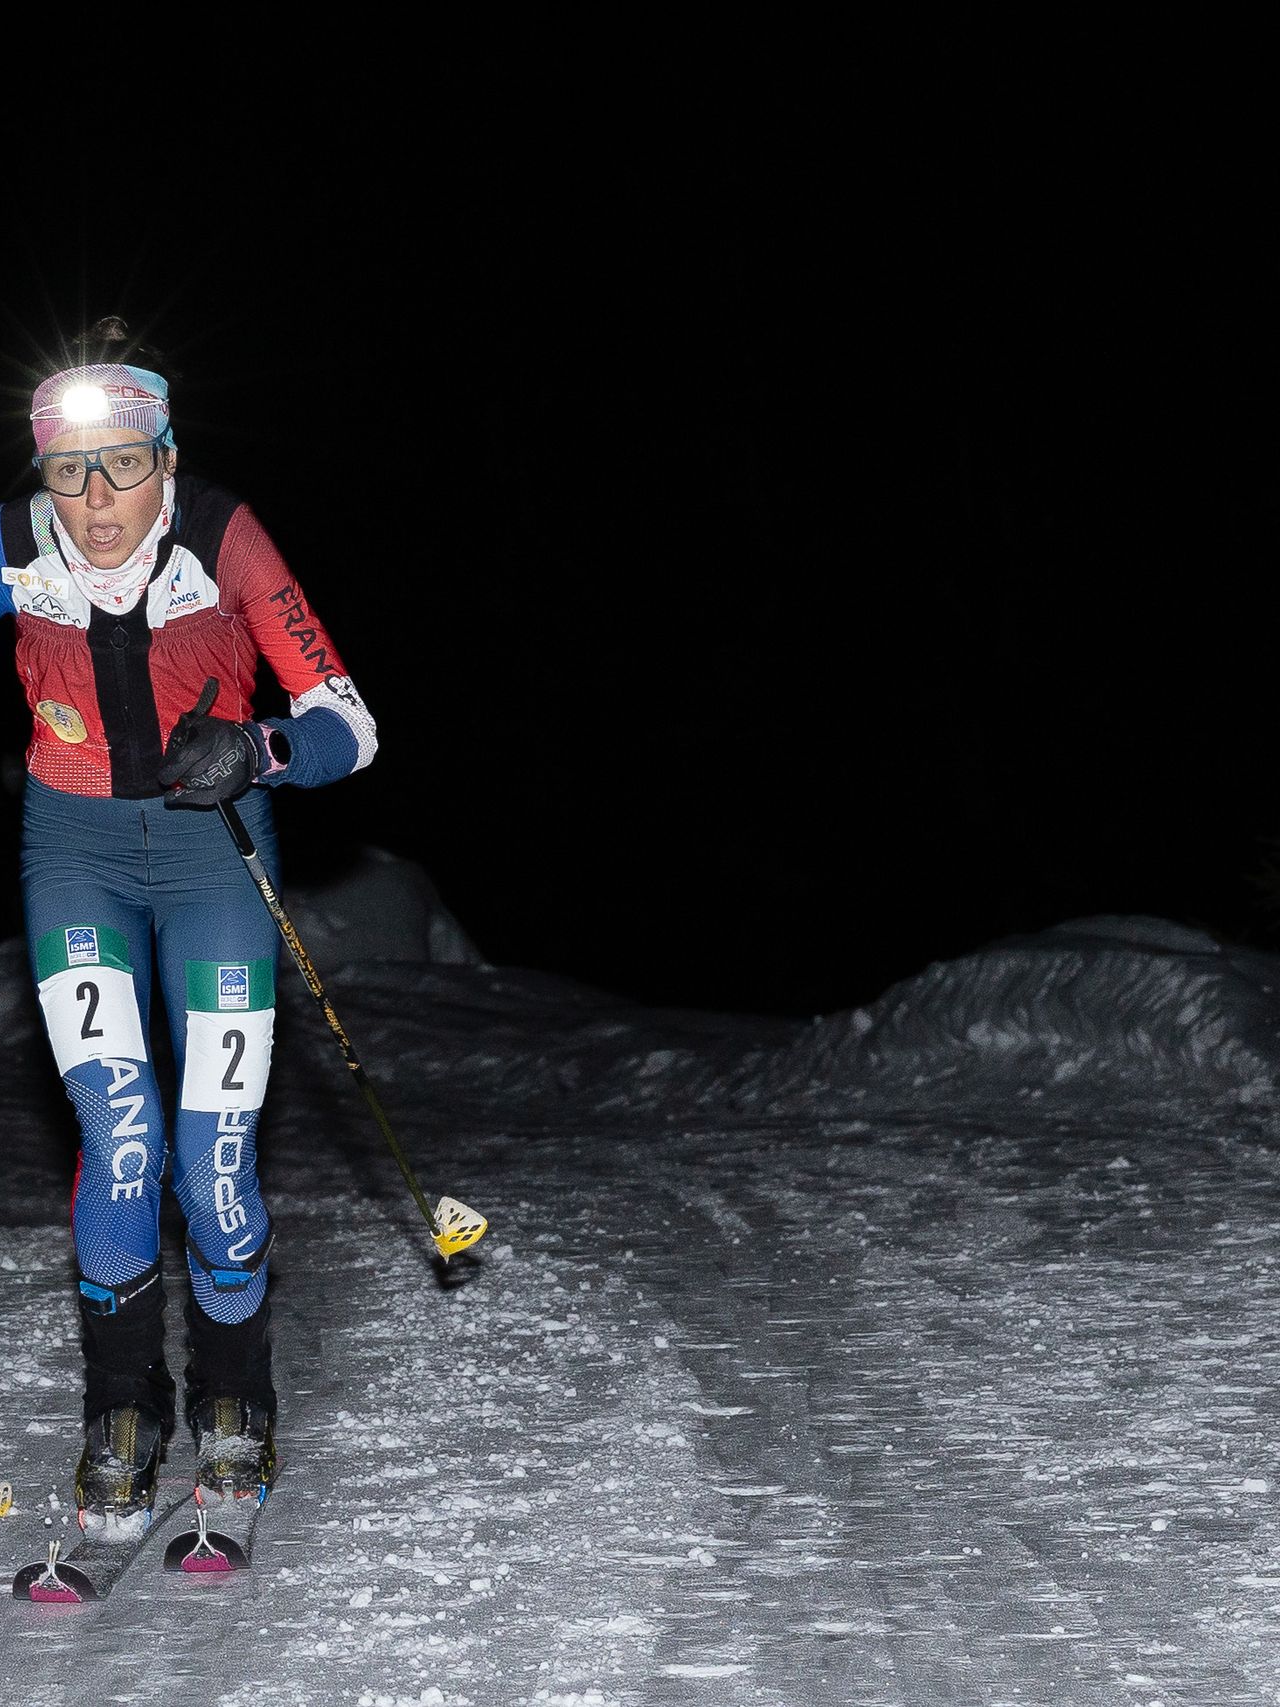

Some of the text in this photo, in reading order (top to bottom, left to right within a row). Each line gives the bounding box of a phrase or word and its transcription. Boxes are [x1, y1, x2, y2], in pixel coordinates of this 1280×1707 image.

[169, 591, 201, 607] ANCE
[70, 942, 95, 952] ISMF
[222, 984, 246, 995] ISMF
[75, 981, 103, 1040] 2
[222, 1030, 246, 1090] 2
[100, 1058, 148, 1202] ANCE
